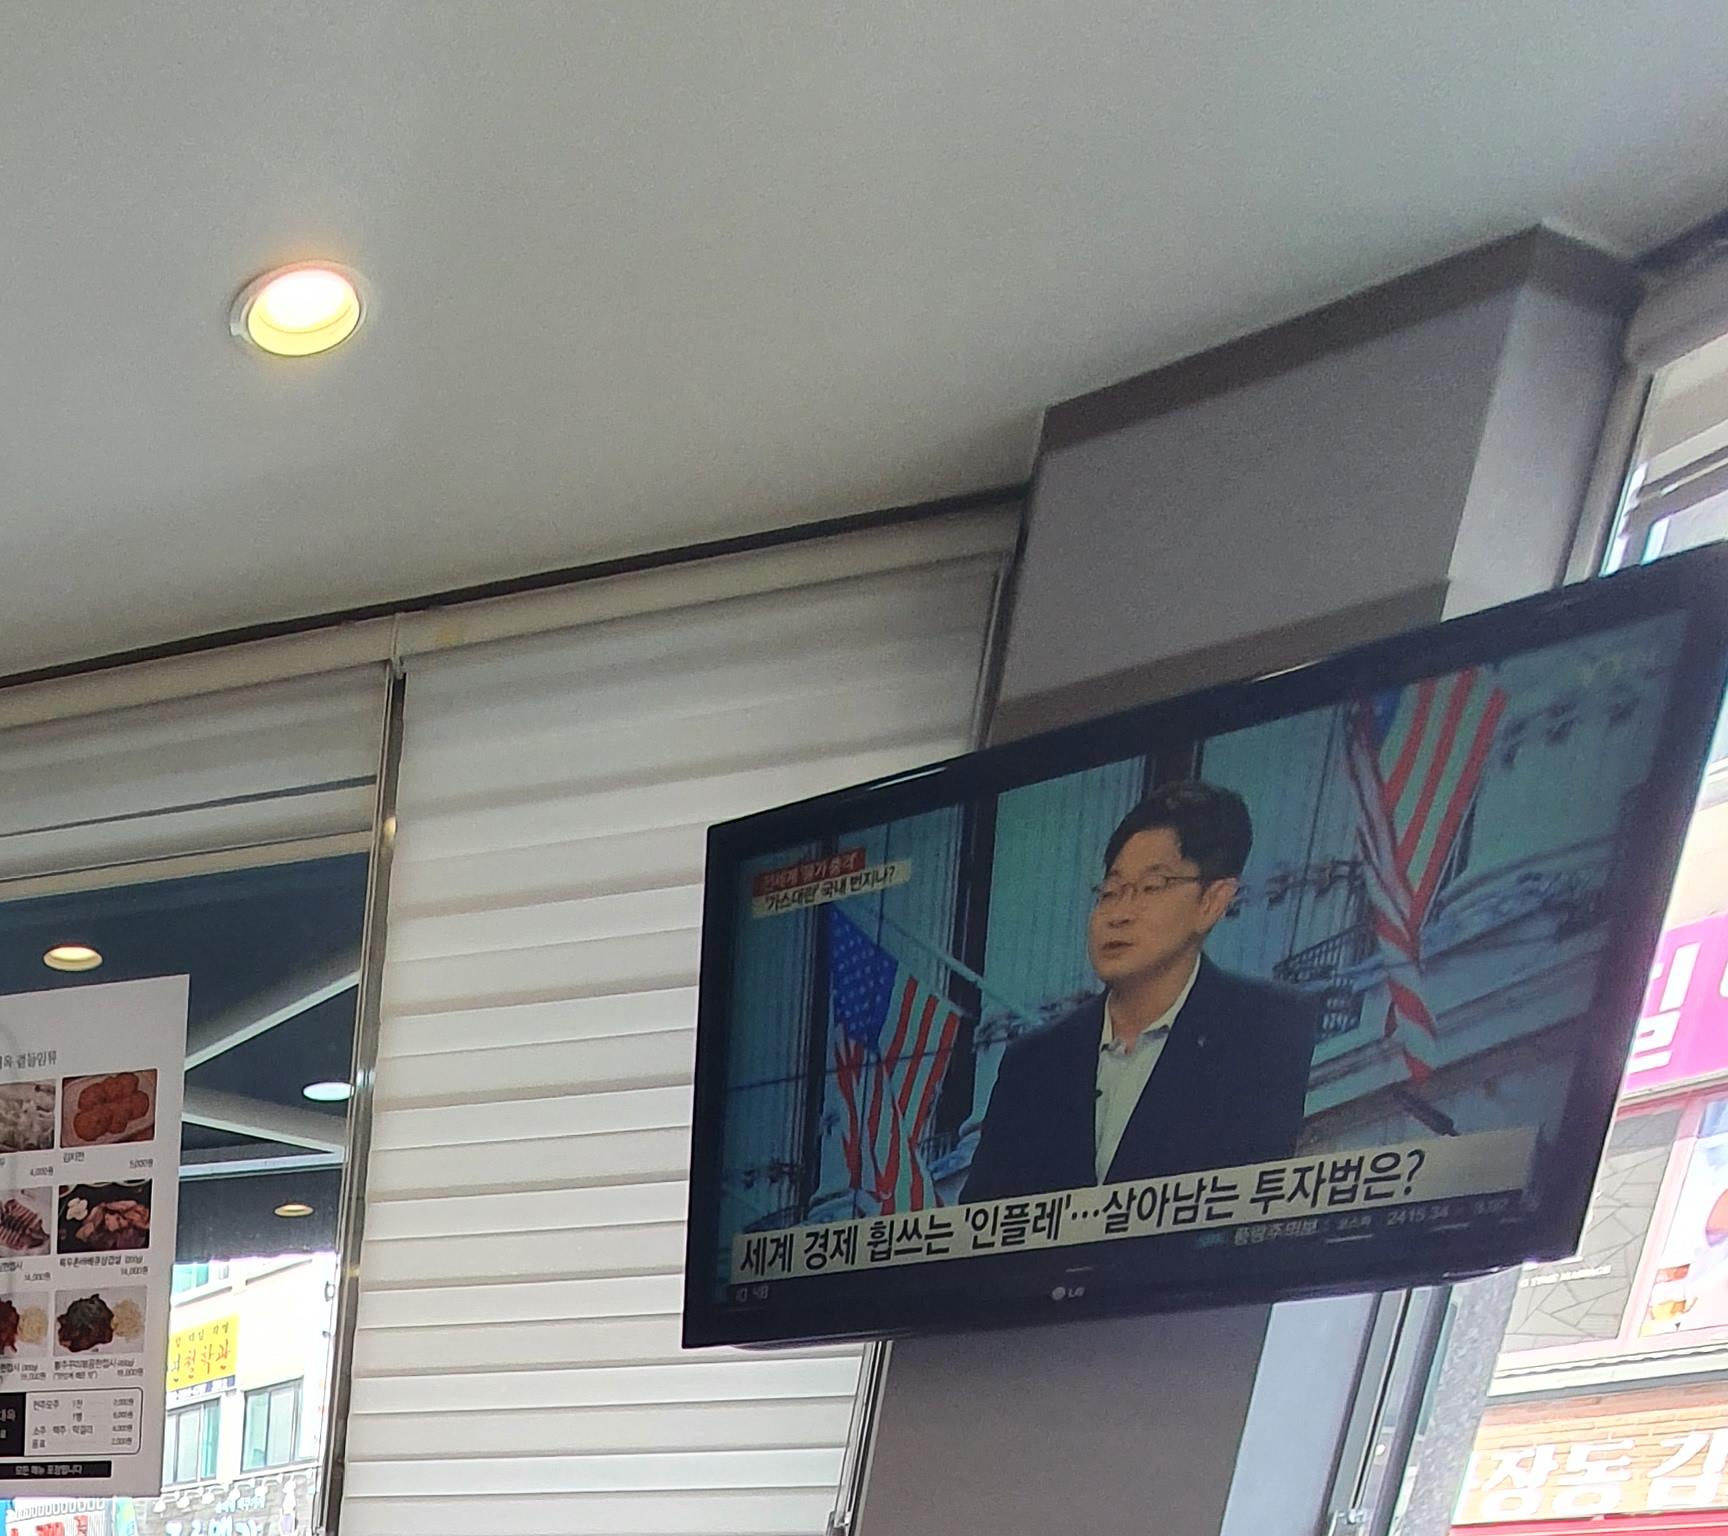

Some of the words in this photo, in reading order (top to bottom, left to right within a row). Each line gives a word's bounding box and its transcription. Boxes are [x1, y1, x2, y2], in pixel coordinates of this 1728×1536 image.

[740, 1231, 795, 1277] 세계
[803, 1224, 859, 1271] 경제
[867, 1217, 955, 1263] 휩쓰는
[1249, 1147, 1428, 1220] 투자법은?
